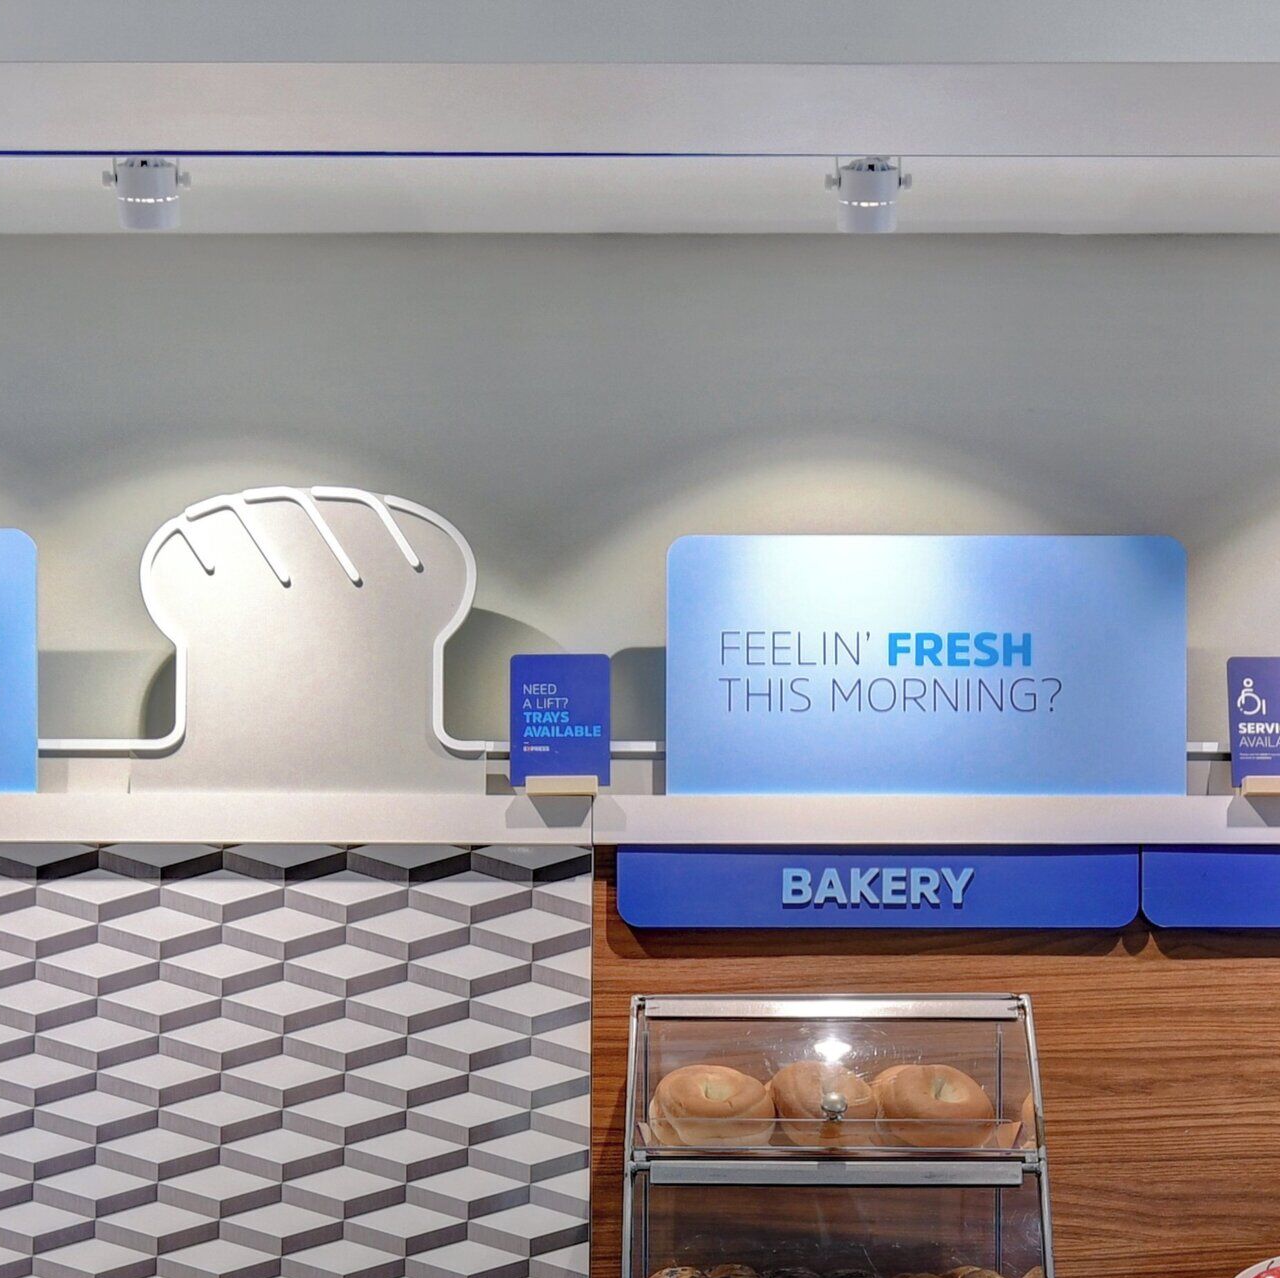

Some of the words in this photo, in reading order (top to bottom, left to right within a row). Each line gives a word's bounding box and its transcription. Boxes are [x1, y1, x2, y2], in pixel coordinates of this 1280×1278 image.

[885, 630, 1033, 669] FRESH
[522, 683, 558, 696] NEED
[718, 676, 813, 713] THIS
[828, 676, 1065, 715] MORNING?
[522, 698, 533, 710] A
[536, 698, 570, 710] LIFT?
[523, 711, 570, 724] TRAYS
[523, 725, 602, 738] AVAILABLE
[780, 866, 975, 908] BAKERY
